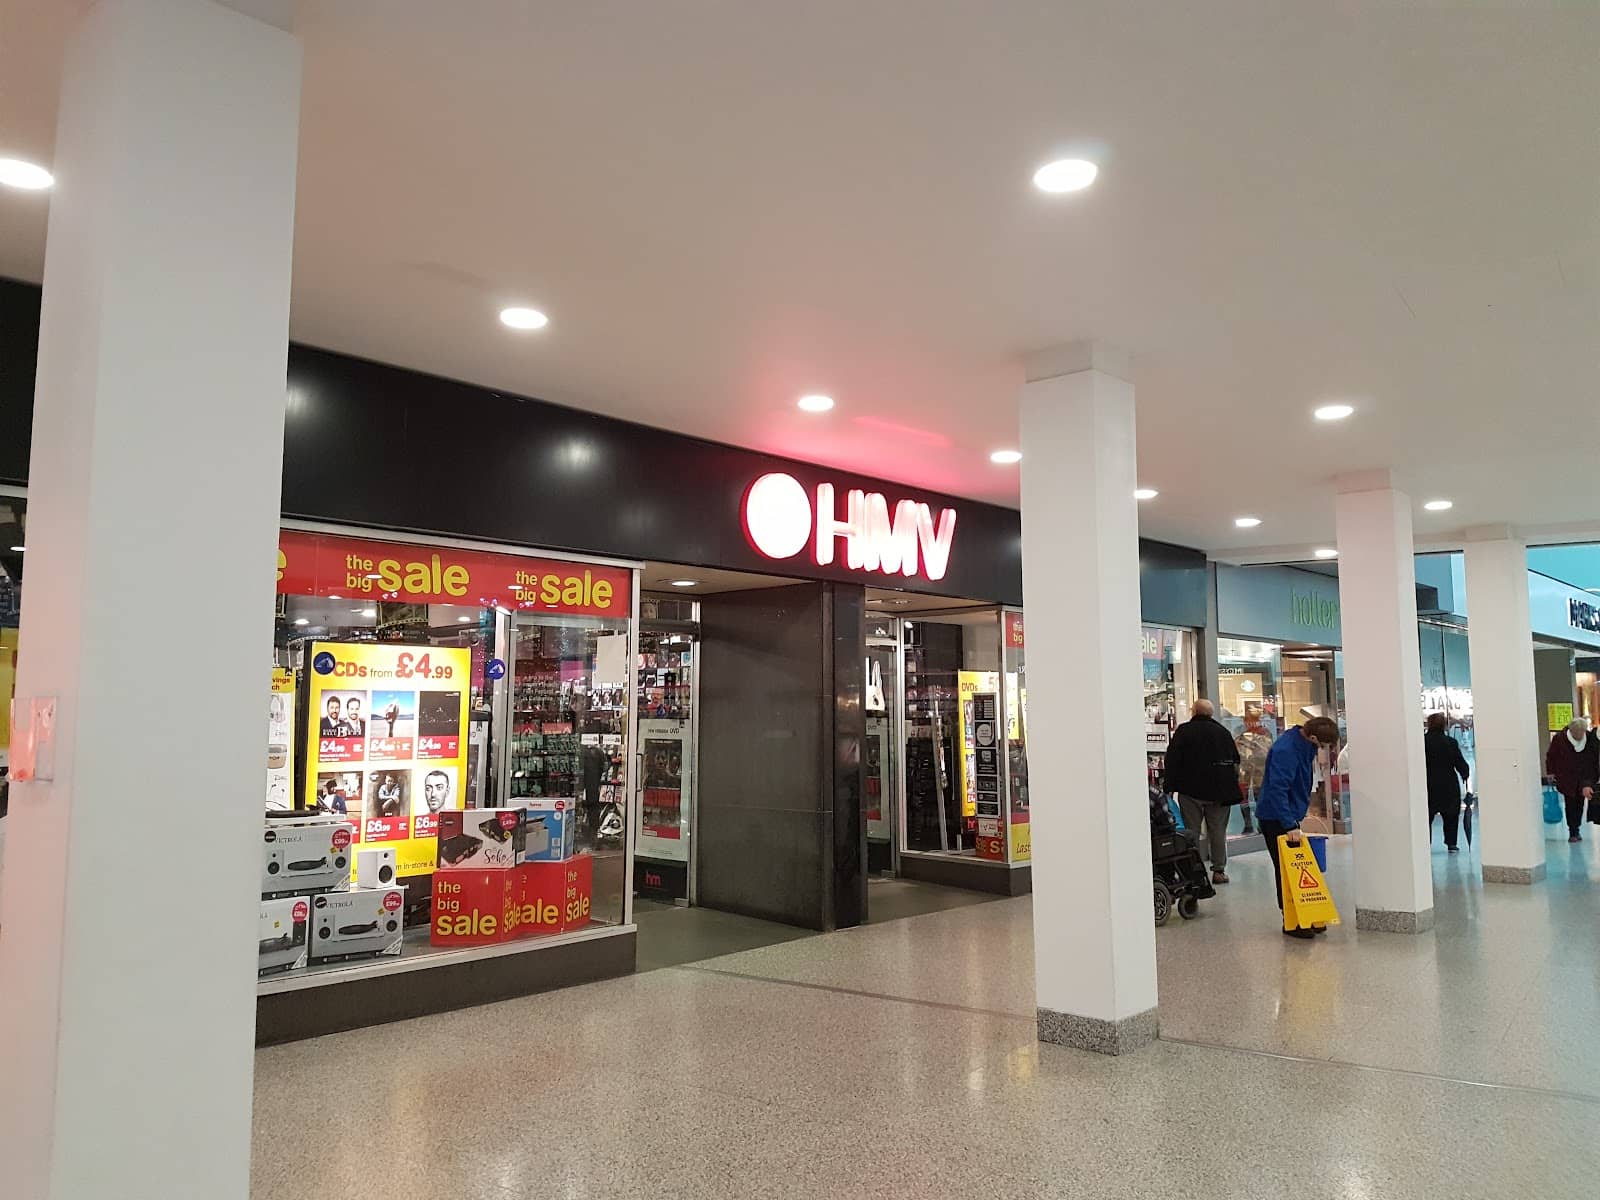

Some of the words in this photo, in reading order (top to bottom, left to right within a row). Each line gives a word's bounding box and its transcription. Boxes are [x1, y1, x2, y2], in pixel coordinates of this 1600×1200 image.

[816, 482, 957, 581] HMV
[345, 554, 374, 571] the
[377, 553, 470, 597] sale
[346, 573, 373, 592] big
[516, 570, 538, 585] the
[540, 569, 613, 609] sale
[516, 587, 537, 603] big
[1141, 632, 1157, 654] ale
[333, 661, 367, 677] CDs
[370, 668, 393, 678] from
[395, 652, 453, 679] £4.99
[437, 881, 461, 894] the
[437, 897, 460, 912] big
[503, 901, 521, 933] sale
[520, 898, 559, 925] ale
[566, 892, 590, 922] sale
[436, 908, 498, 936] sale
